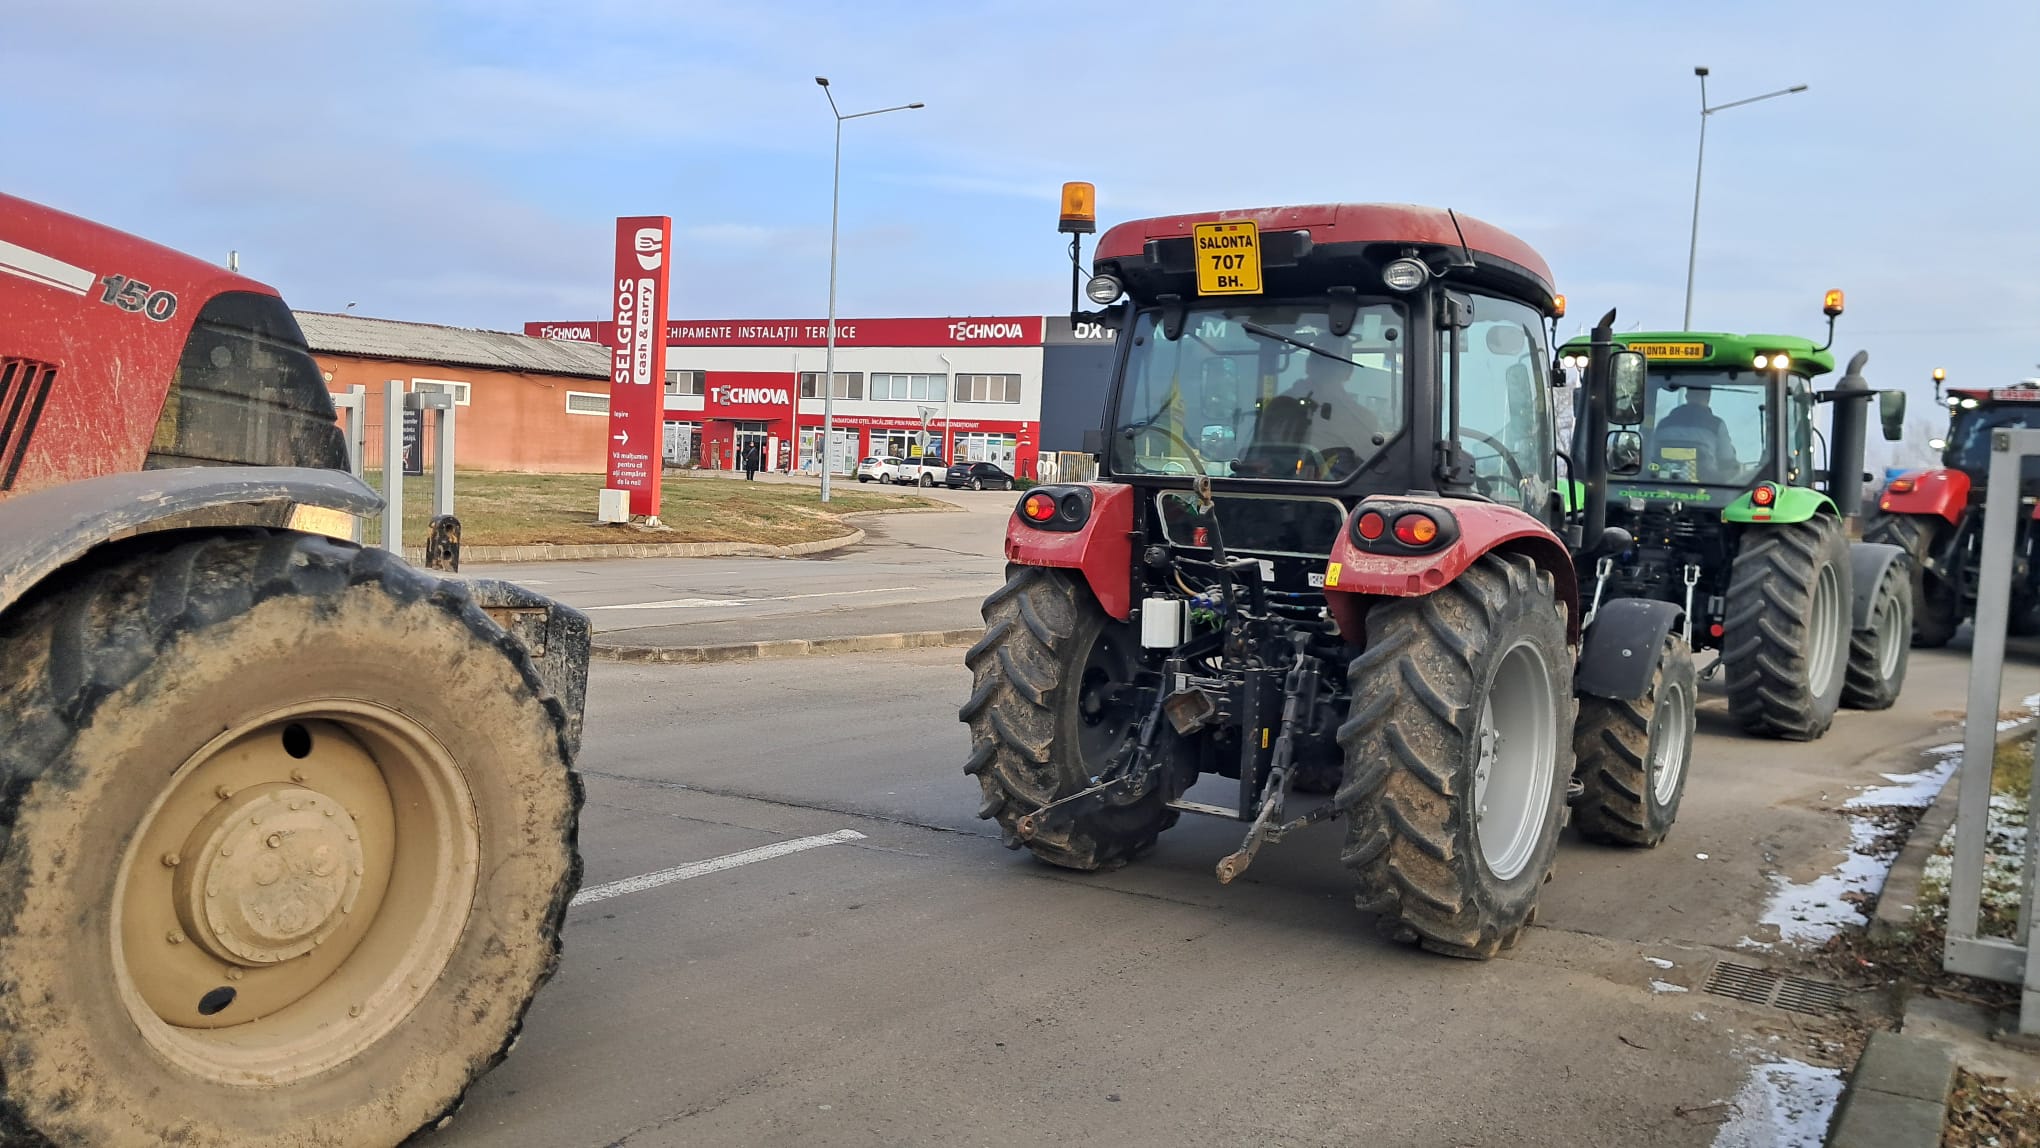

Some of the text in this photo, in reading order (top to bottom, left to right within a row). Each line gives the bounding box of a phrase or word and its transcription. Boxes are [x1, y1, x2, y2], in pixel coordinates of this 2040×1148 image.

[1199, 235, 1253, 249] SALONTA
[1211, 254, 1245, 270] 707
[1217, 275, 1244, 288] BH.
[101, 274, 177, 322] 150
[615, 278, 634, 384] SELGROS
[638, 286, 652, 376] cash & carry
[948, 321, 1023, 341] TECHNOVA
[711, 385, 789, 406] TECHNOVA
